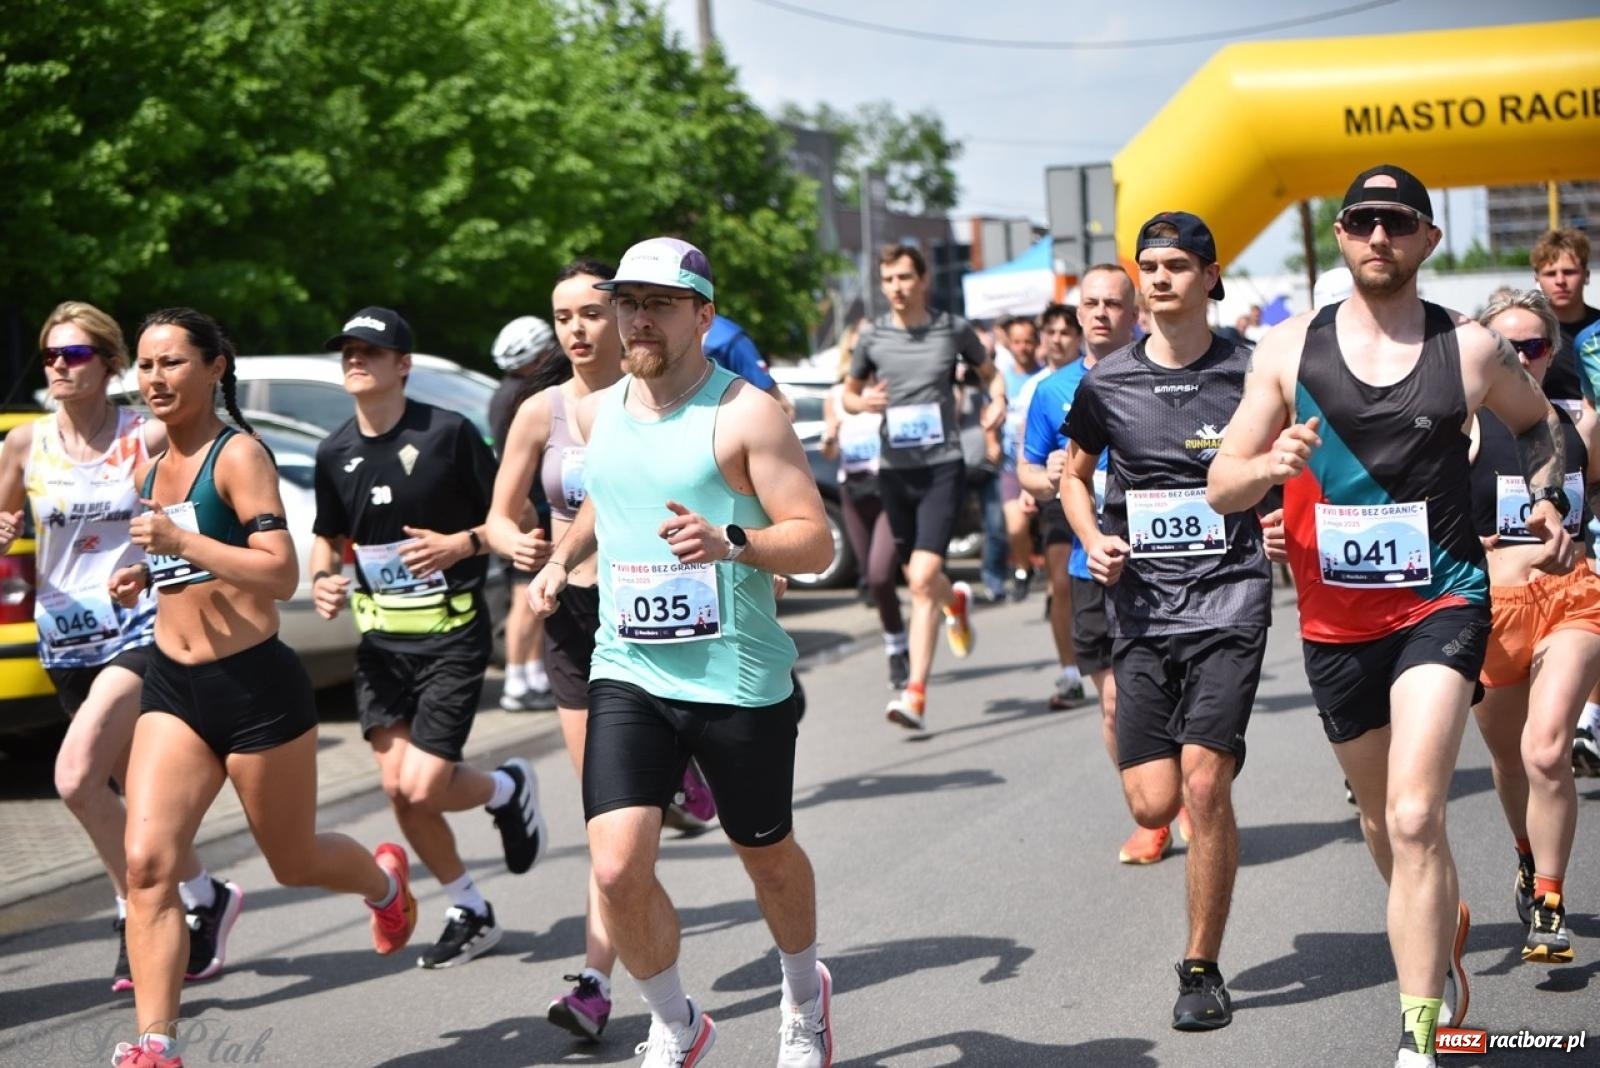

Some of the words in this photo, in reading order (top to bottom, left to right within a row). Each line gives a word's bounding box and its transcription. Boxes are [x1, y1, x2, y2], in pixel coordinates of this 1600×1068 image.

[1344, 97, 1487, 136] MIASTO
[1184, 489, 1206, 497] GRAN
[1338, 508, 1360, 517] BIEG
[1361, 508, 1380, 516] BEZ
[1381, 504, 1419, 516] GRANIC
[1151, 516, 1202, 539] 038
[1344, 539, 1397, 566] 041
[380, 564, 418, 585] 04
[631, 564, 650, 573] BIEG
[652, 564, 668, 573] BEZ
[670, 563, 707, 573] GRANIC
[634, 594, 691, 622] 035
[55, 609, 98, 635] 046
